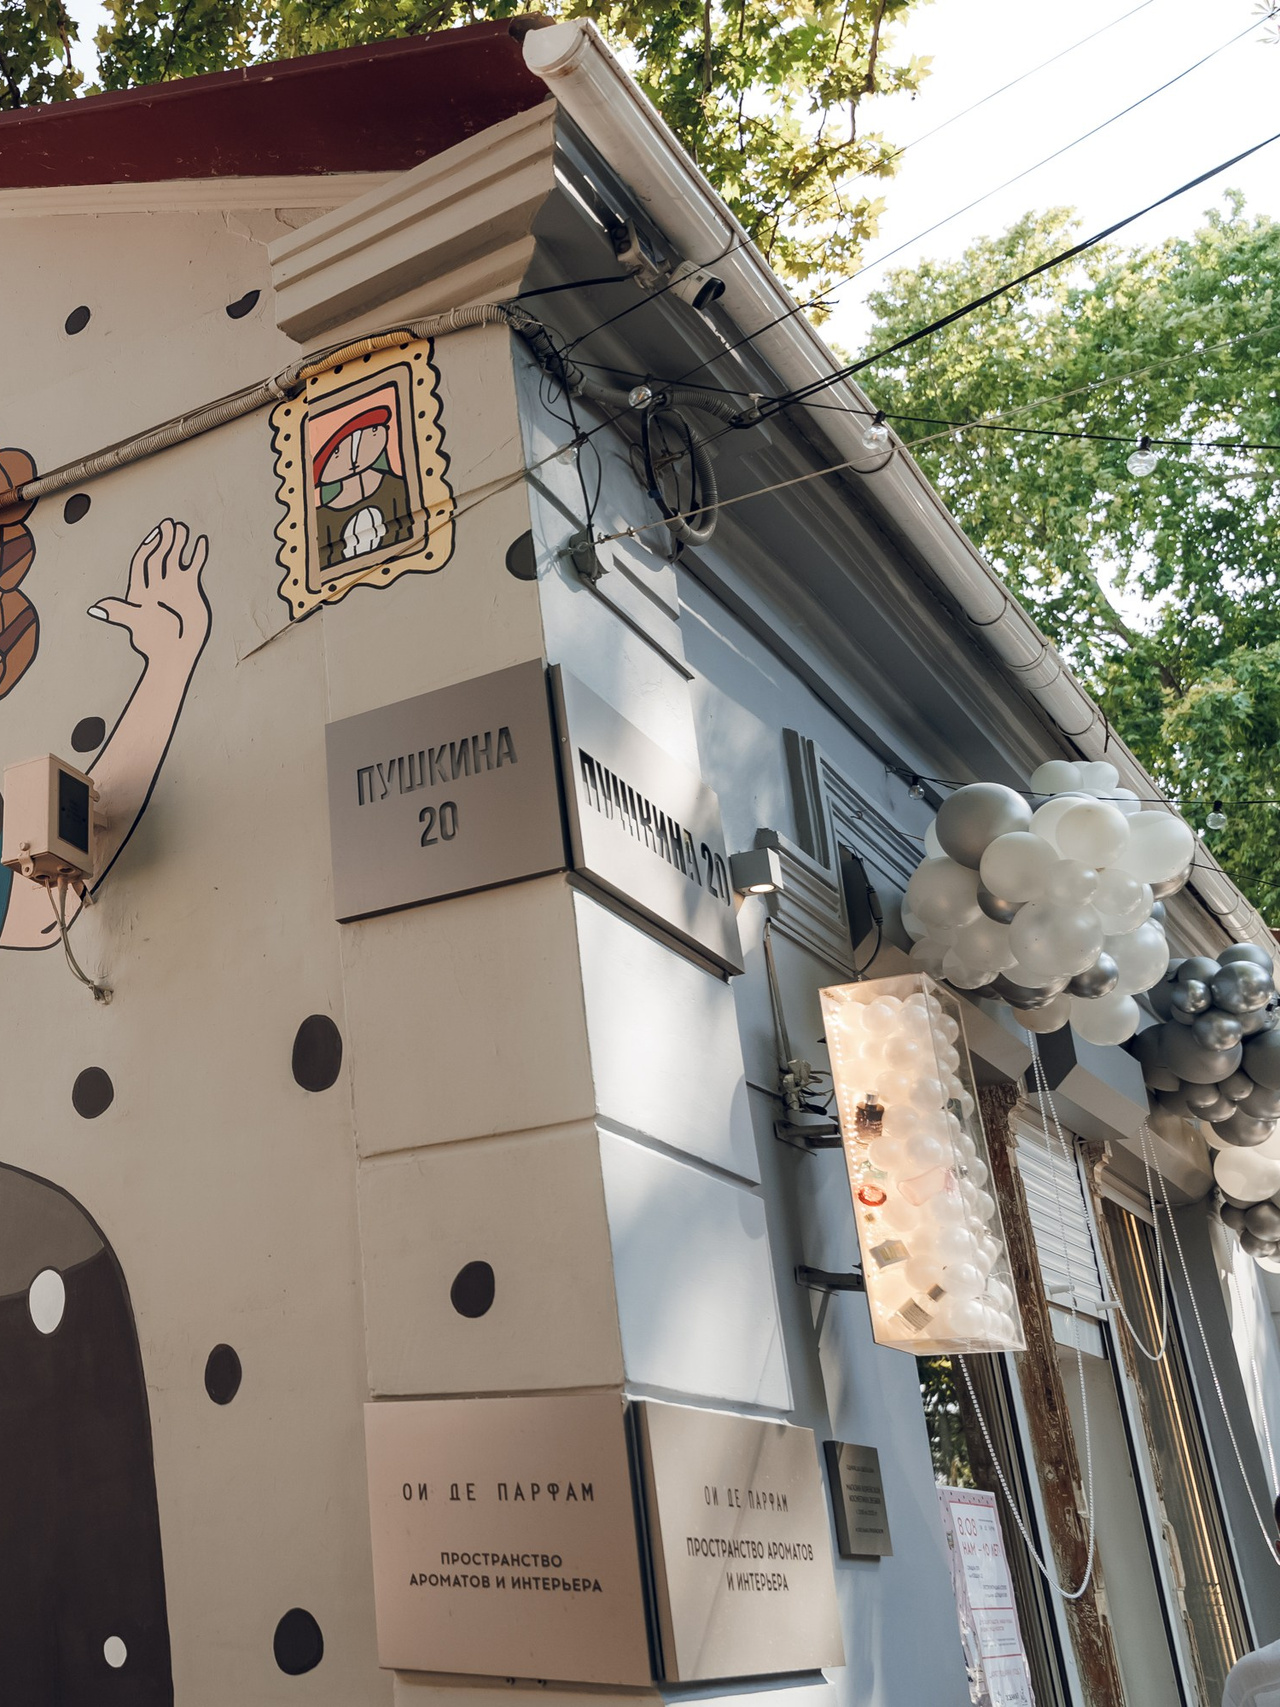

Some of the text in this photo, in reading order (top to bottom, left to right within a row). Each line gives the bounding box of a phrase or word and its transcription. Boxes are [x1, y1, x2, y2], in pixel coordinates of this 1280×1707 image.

[356, 726, 518, 806] ПУШКИНА
[418, 801, 459, 847] 20
[578, 747, 731, 907] ПУШКИНА 20
[402, 1482, 595, 1502] ОИ ДЕ ПАРФАМ
[704, 1485, 789, 1512] ОИ ДЕ ПАРФАМ
[440, 1551, 563, 1569] ПРОСТРАНСТВО
[686, 1537, 814, 1561] ПРОСТРАНСТВО АРОМАТОВ
[409, 1573, 603, 1593] АРОМАТОВ И ИНТЕРЬЕРА
[726, 1571, 789, 1591] И ИНТЕРЬЕРА
